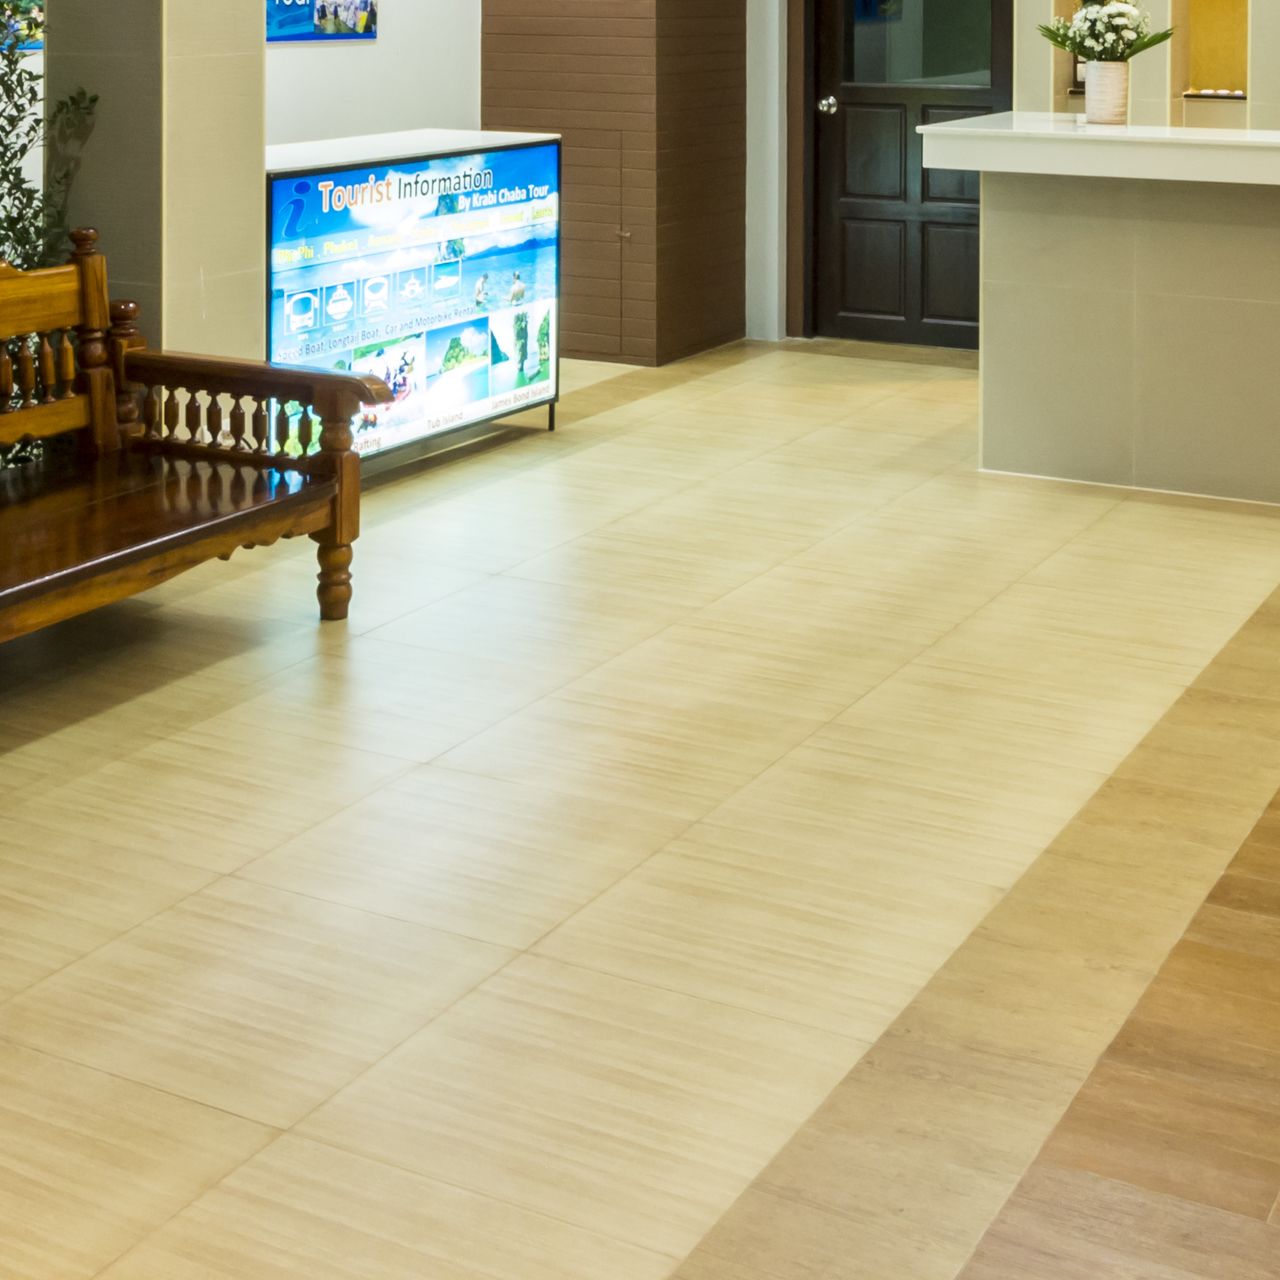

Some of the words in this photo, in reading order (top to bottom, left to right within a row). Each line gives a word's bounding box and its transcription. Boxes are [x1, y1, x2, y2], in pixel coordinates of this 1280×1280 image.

[318, 174, 393, 214] Tourist
[397, 167, 493, 200] Information
[458, 195, 471, 212] By
[472, 190, 497, 208] Krabi
[498, 186, 527, 203] Chaba
[528, 184, 550, 199] Tour
